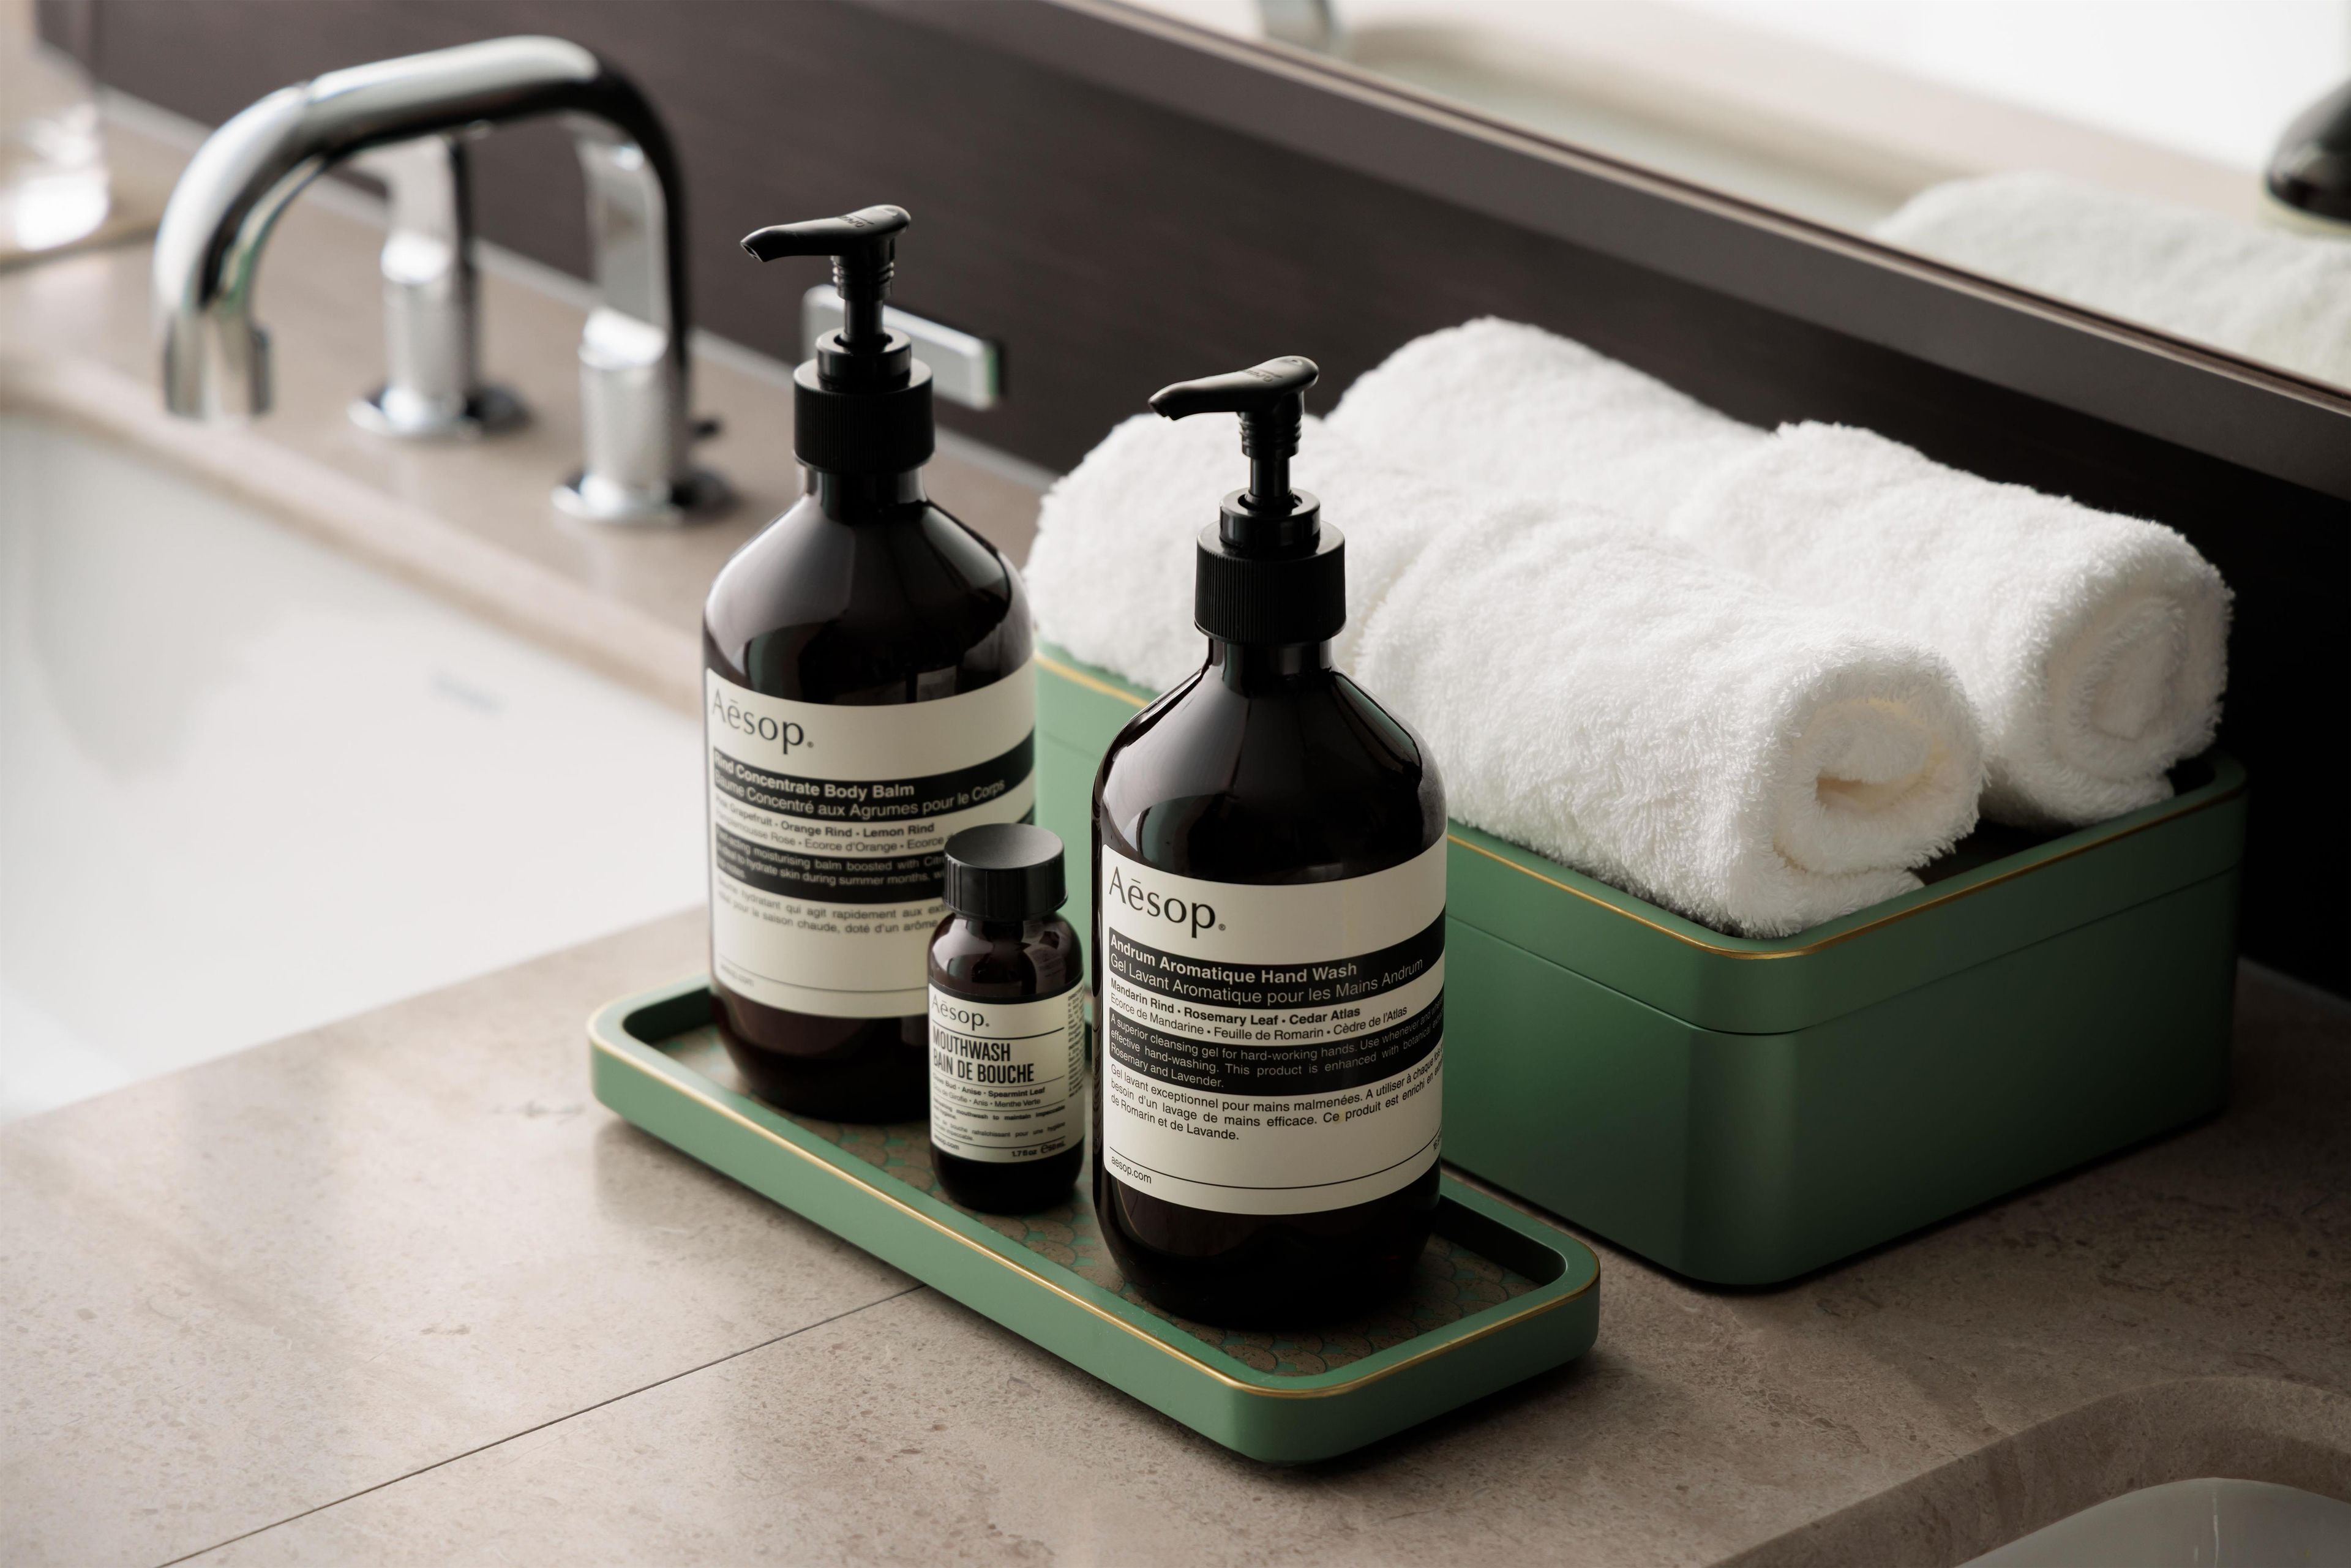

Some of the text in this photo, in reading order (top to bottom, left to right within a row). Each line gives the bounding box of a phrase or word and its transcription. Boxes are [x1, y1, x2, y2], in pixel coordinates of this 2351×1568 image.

[714, 751, 915, 801] Rind Concentrate Body Balm
[715, 769, 744, 797] Baume
[746, 787, 814, 814] Concentré
[818, 806, 845, 816] aux
[850, 803, 918, 820] Agrumes
[922, 797, 954, 814] pour
[957, 792, 970, 805] le
[972, 779, 1006, 801] Corps
[730, 801, 773, 827] Grapefruit
[781, 820, 822, 836] Orange
[825, 826, 853, 837] Rind
[863, 827, 904, 838] Lemon
[908, 822, 935, 835] Rind
[754, 846, 811, 870] moisturising
[814, 859, 842, 871] balm
[847, 860, 892, 871] boosted
[897, 858, 920, 869] with
[771, 831, 796, 846] Rose
[805, 838, 842, 851] Ecorce
[846, 840, 898, 853] d'Orange
[907, 836, 944, 850] Ecorce
[746, 857, 778, 876] hydrate
[779, 867, 800, 879] skin
[803, 872, 836, 886] during
[839, 876, 884, 886] summer
[763, 912, 793, 926] saison
[797, 919, 841, 934] chaude,
[845, 923, 870, 934] doté
[874, 923, 899, 934] d'un
[903, 919, 939, 932] arôme
[786, 903, 801, 915] qui
[807, 907, 827, 919] agit
[833, 910, 896, 920] rapidement
[902, 909, 922, 918] aux
[1111, 934, 1357, 986] Andrum Aromatique Hand Wash
[1111, 953, 1423, 1006] Gel Lavant Aromatique pour les Mains Andrum
[1111, 977, 1360, 1027] Mandarin Rind Rosemary Leaf Cedar Atlas
[1111, 992, 1408, 1040] Ecorce de Mandarine Feuille de Romarin Cèdre de l'Atlas
[932, 1025, 1011, 1062] MOUTHWASH
[1111, 1013, 1116, 1025] A
[1117, 1018, 1149, 1040] superior
[1150, 1034, 1199, 1057] cleansing
[1201, 1046, 1219, 1059] gel
[1222, 1048, 1238, 1060] for
[1240, 1049, 1318, 1061] hard-working
[1321, 1045, 1358, 1058] hands.
[1360, 1037, 1380, 1050] Use
[1382, 1019, 1420, 1044] whenever
[1420, 1008, 1431, 1025] and
[1111, 1029, 1140, 1052] effective
[1144, 1046, 1220, 1075] hand-washing.
[1225, 1063, 1250, 1075] This
[1257, 1064, 1302, 1078] product
[1309, 1064, 1318, 1073] is
[1324, 1053, 1377, 1072] enhanced
[1382, 1045, 1400, 1059] with
[1403, 1023, 1431, 1049] botanical
[934, 1048, 1035, 1084] BAIN DE BOUCHE
[1111, 1042, 1224, 1088] Rosemary and Lavender.
[1111, 1063, 1122, 1079] Gel
[1124, 1071, 1149, 1092] lavant
[1151, 1086, 1218, 1108] exceptionnel
[1222, 1101, 1250, 1112] pour
[1253, 1101, 1290, 1112] mains
[1294, 1093, 1363, 1111] malmenées.
[1365, 1089, 1373, 1100] A
[1376, 1078, 1405, 1097] utiliser
[1406, 1073, 1412, 1084] à
[1413, 1058, 1434, 1081] chaque
[945, 1080, 957, 1090] Bud
[961, 1086, 982, 1096] Anise
[988, 1090, 1029, 1098] Spearmint
[1030, 1086, 1046, 1096] Leaf
[973, 1098, 989, 1107] Anis
[1111, 1074, 1434, 1127] besoin d'un lavage de mains efficace. Ce produit est enrichi en
[956, 1108, 989, 1120] mouthwash
[1111, 1093, 1240, 1141] de Romarin et de Lavande.
[1111, 1156, 1152, 1184] aesop.com
